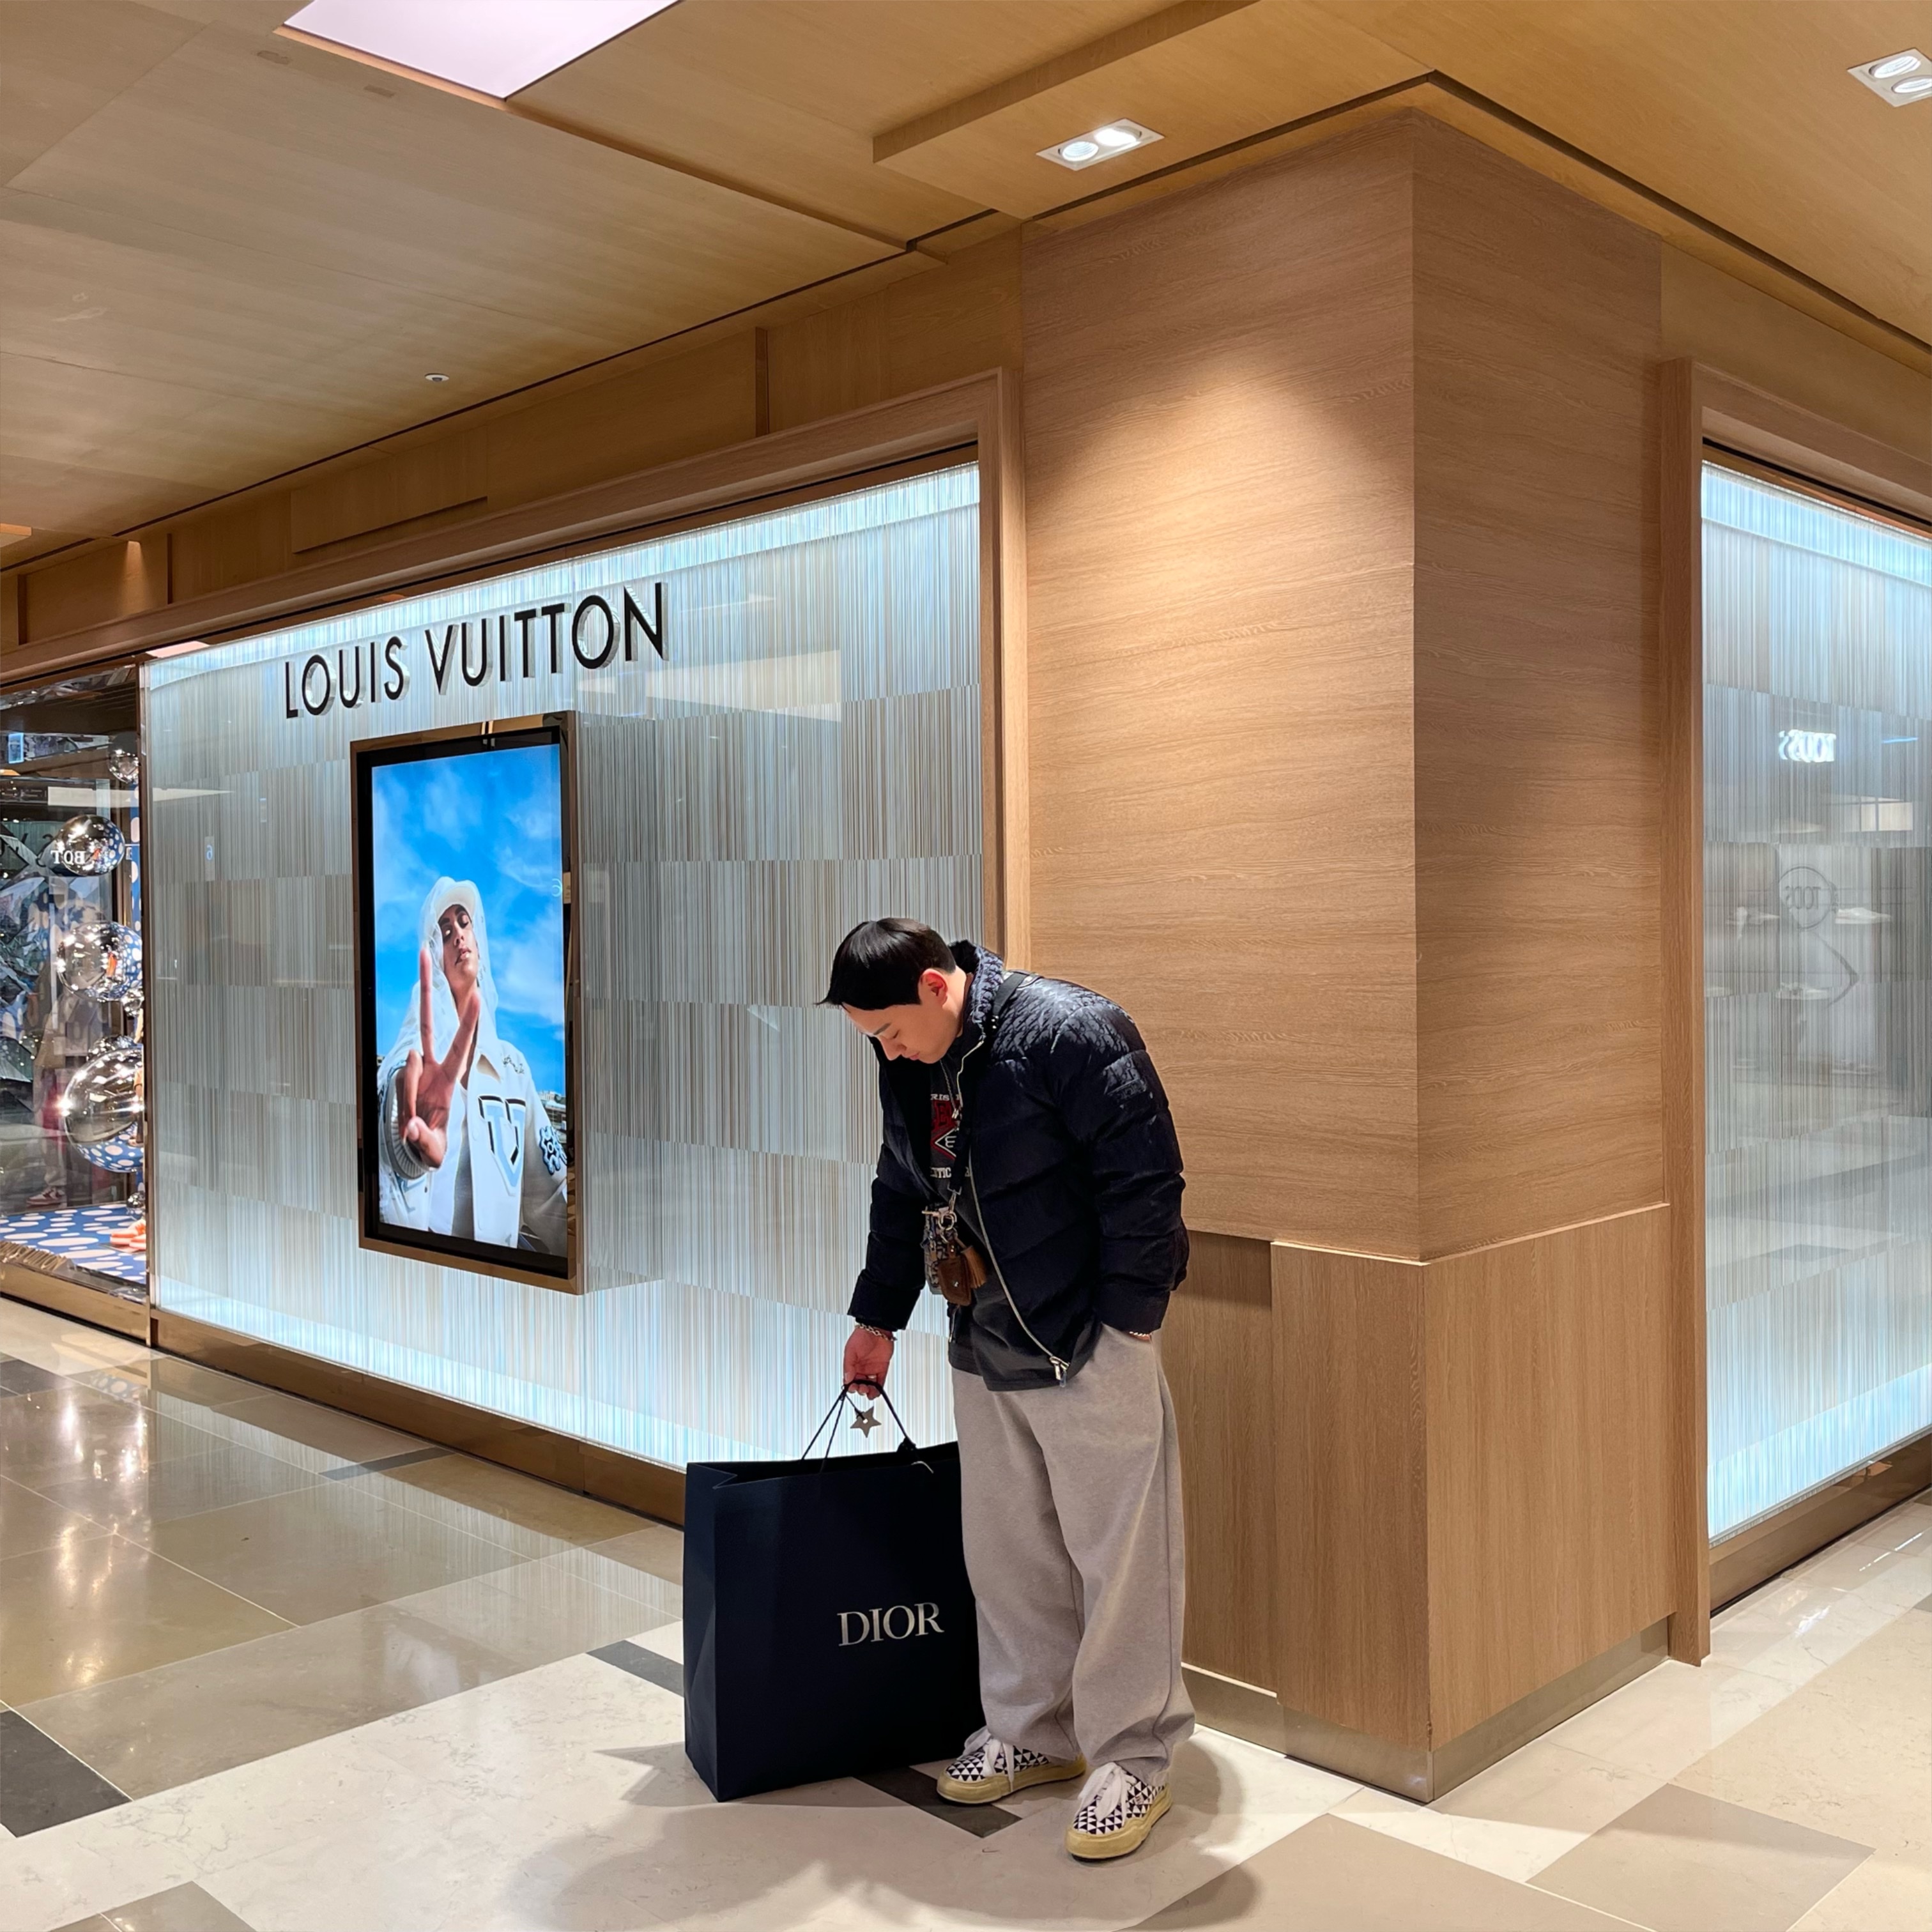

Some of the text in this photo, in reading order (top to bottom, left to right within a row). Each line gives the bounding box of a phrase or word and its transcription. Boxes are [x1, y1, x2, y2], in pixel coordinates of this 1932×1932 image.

[285, 581, 669, 719] LOUIS VUITTON
[836, 1602, 945, 1647] DIOR
